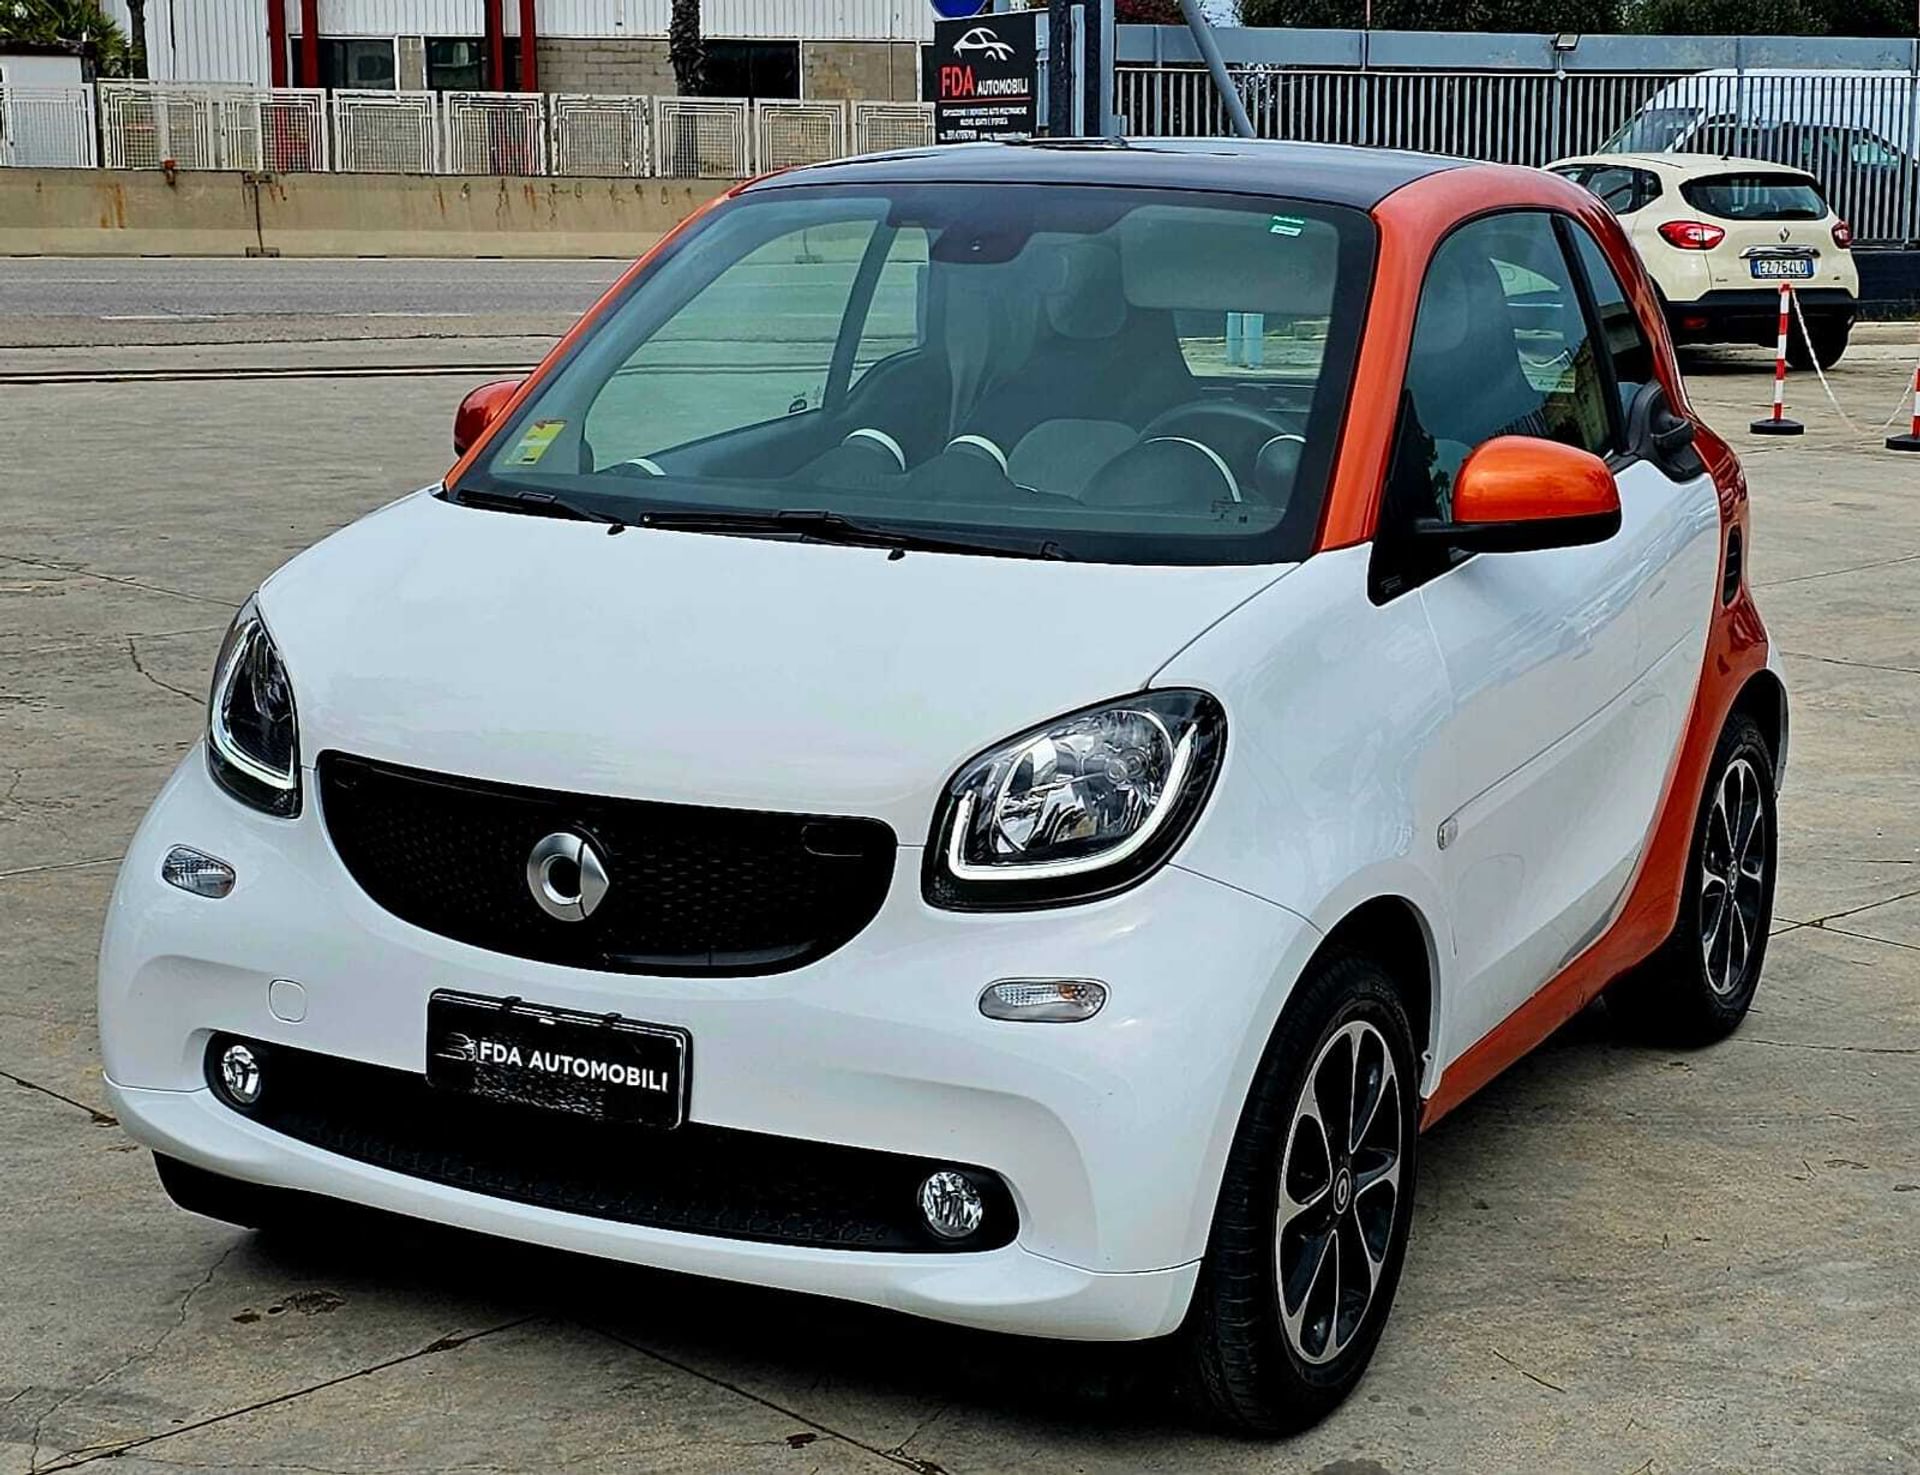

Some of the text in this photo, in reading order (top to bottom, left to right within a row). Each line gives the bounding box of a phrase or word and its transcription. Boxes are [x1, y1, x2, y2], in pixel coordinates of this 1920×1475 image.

[941, 65, 1029, 97] FDA AUTOMOBILI
[480, 1042, 669, 1093] FDA AUTOMOBILI
